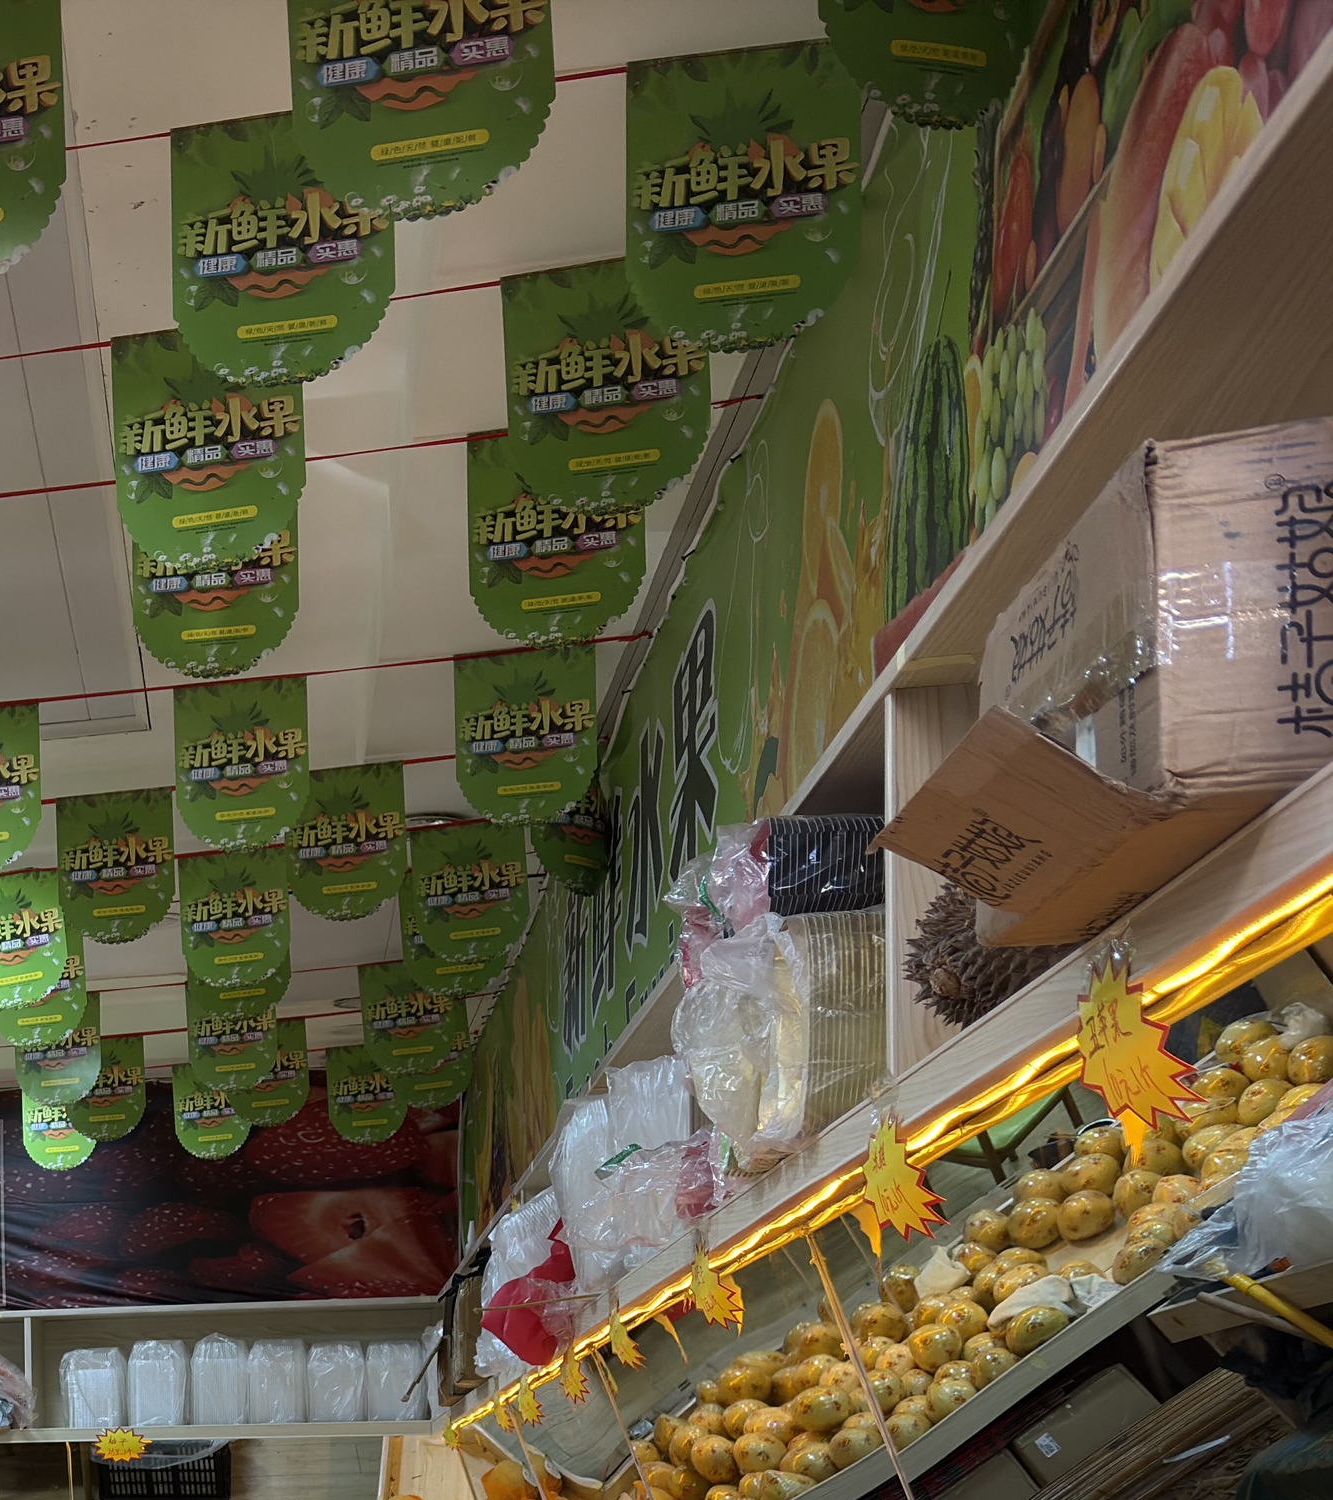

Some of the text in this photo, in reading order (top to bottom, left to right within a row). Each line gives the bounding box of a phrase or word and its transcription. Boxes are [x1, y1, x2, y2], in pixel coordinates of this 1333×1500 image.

[322, 35, 509, 83] 健康 精品 实惠
[633, 136, 859, 209] 新鲜水果
[655, 193, 823, 228] 健康 精品 实惠
[512, 330, 707, 395] 新鲜水果
[119, 394, 302, 454] 新鲜水果
[138, 439, 273, 469] 健康 精品 实惠
[460, 699, 595, 740] 新鲜水果
[179, 728, 307, 768] 新鲜水果
[288, 811, 404, 847] 新鲜水果
[61, 836, 173, 870] 新鲜水果
[416, 861, 526, 896] 新鲜水果
[183, 888, 288, 922] 新鲜水果
